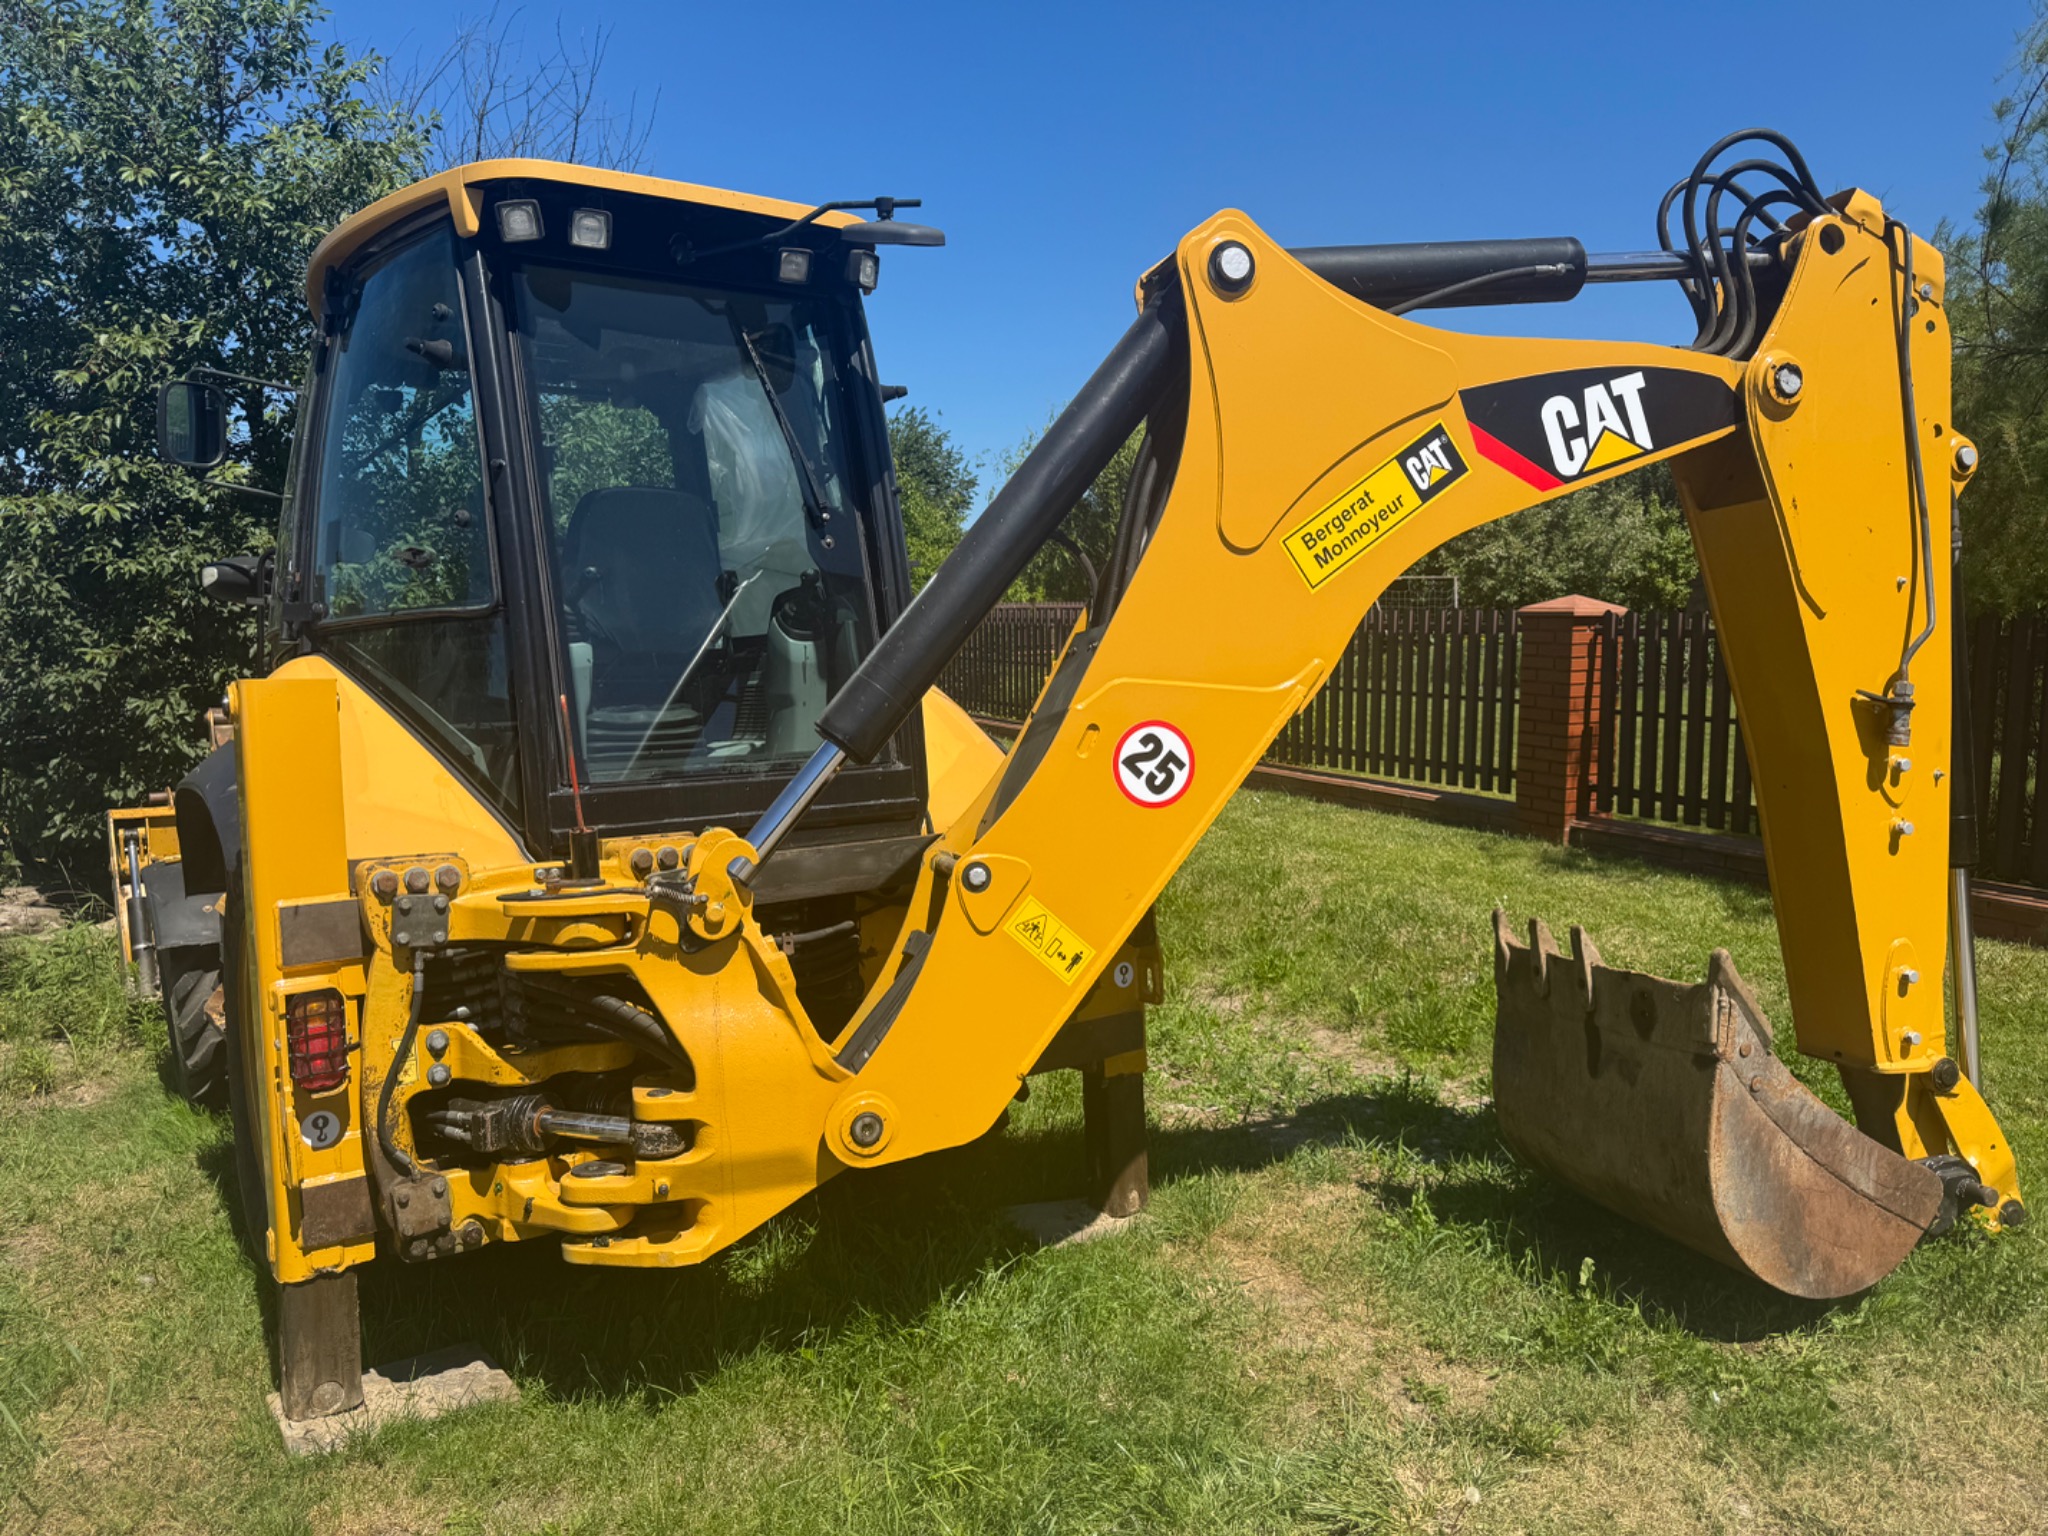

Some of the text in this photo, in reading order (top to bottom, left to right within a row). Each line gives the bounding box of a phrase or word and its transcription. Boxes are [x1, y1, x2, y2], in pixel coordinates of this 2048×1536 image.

[1541, 371, 1653, 477] CAT
[1301, 489, 1375, 551] Bergerat
[1313, 494, 1404, 569] Monnoyeur
[1121, 733, 1186, 795] 25
